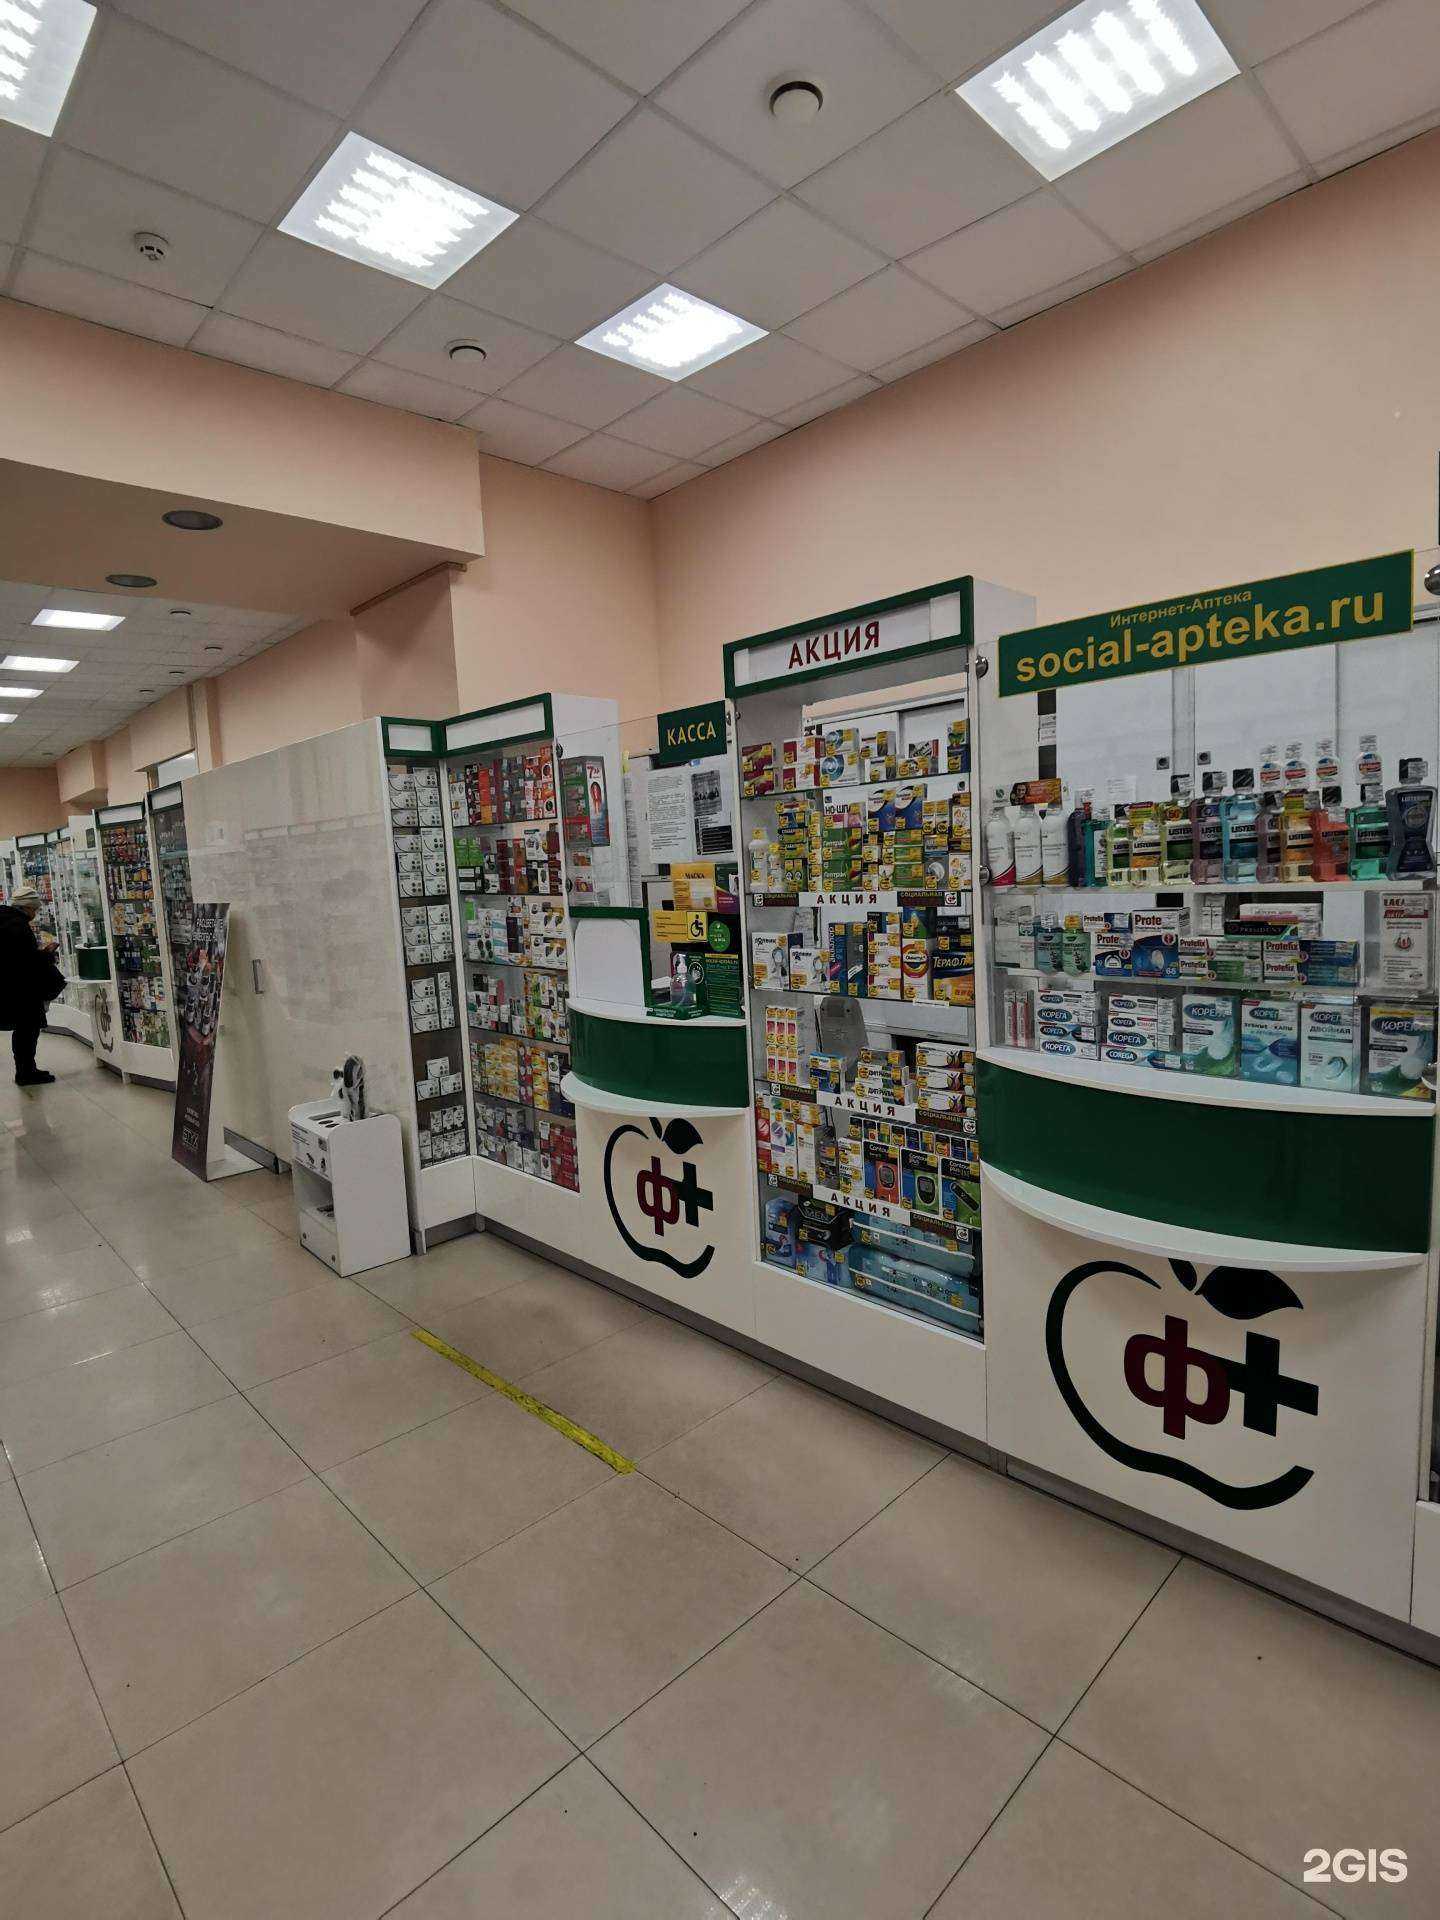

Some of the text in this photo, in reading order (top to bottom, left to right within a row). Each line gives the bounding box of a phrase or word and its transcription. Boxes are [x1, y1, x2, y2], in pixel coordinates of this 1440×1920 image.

[1110, 590, 1252, 628] Интернет-Аптека
[1016, 591, 1384, 682] social-apteka.ru
[788, 621, 880, 669] АКЦИЯ
[666, 720, 717, 746] КАССА
[824, 804, 850, 814] НО-ШП
[1231, 825, 1256, 833] LISTER
[816, 894, 878, 906] АКЦИЯ
[1135, 914, 1162, 926] Prote
[1096, 933, 1119, 943] Prote
[932, 956, 966, 968] ТЕРАФЛ
[1041, 1010, 1068, 1020] КОРЕГА
[1252, 1009, 1278, 1019] КОРЕГ
[1313, 1012, 1341, 1022] КОРЕГ
[1112, 1032, 1141, 1044] КОРЕГА
[1044, 1043, 1071, 1053] КОРЕГА
[834, 1097, 896, 1117] АКЦИЯ
[830, 1192, 892, 1218] АКЦИЯ
